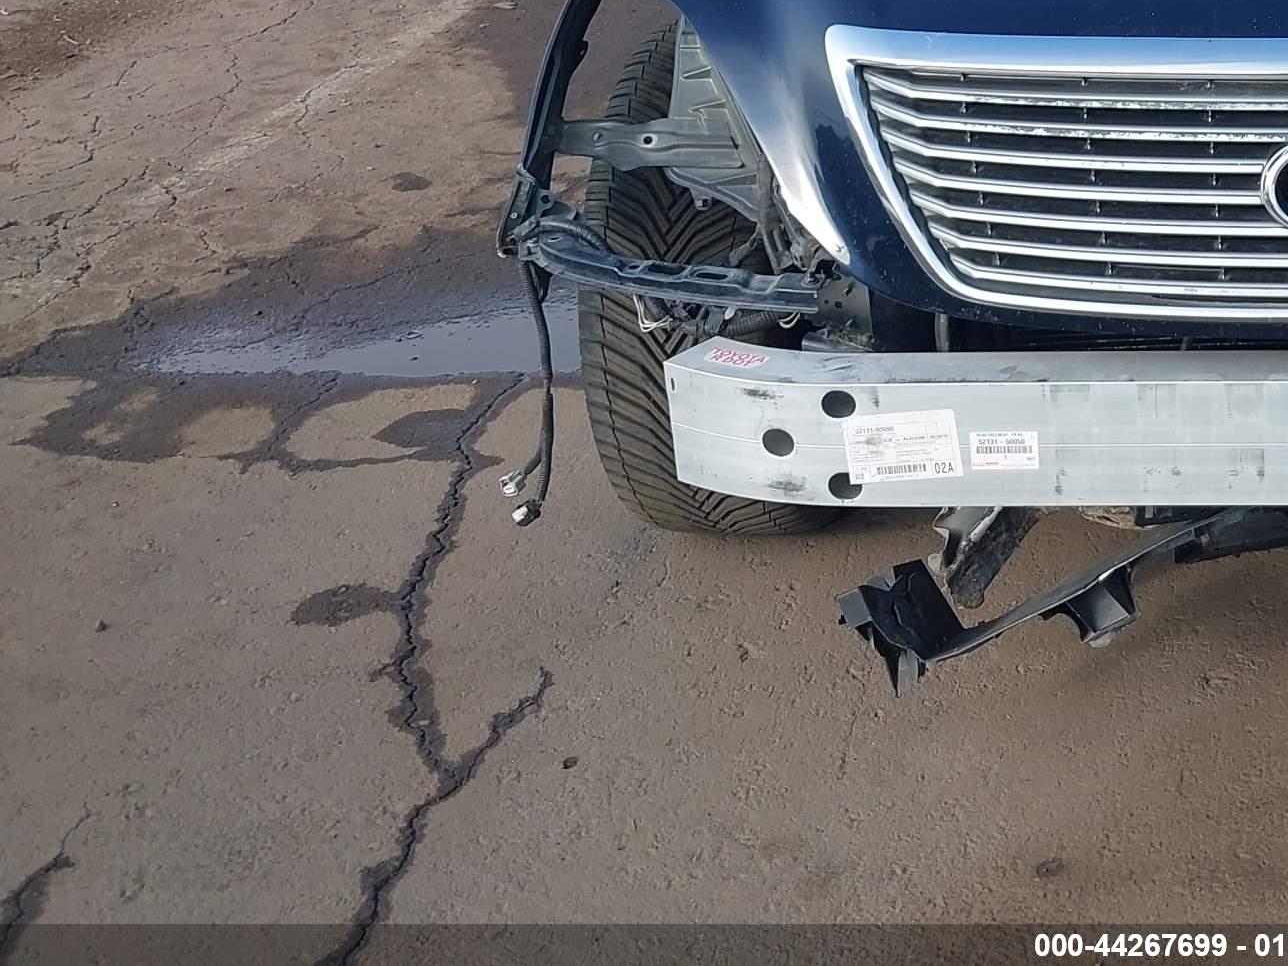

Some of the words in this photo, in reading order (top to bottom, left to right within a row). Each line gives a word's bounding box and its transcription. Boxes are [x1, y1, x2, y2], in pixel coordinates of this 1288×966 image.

[710, 346, 766, 363] TOYOTA
[722, 356, 753, 367] DOT
[934, 461, 954, 475] 02A
